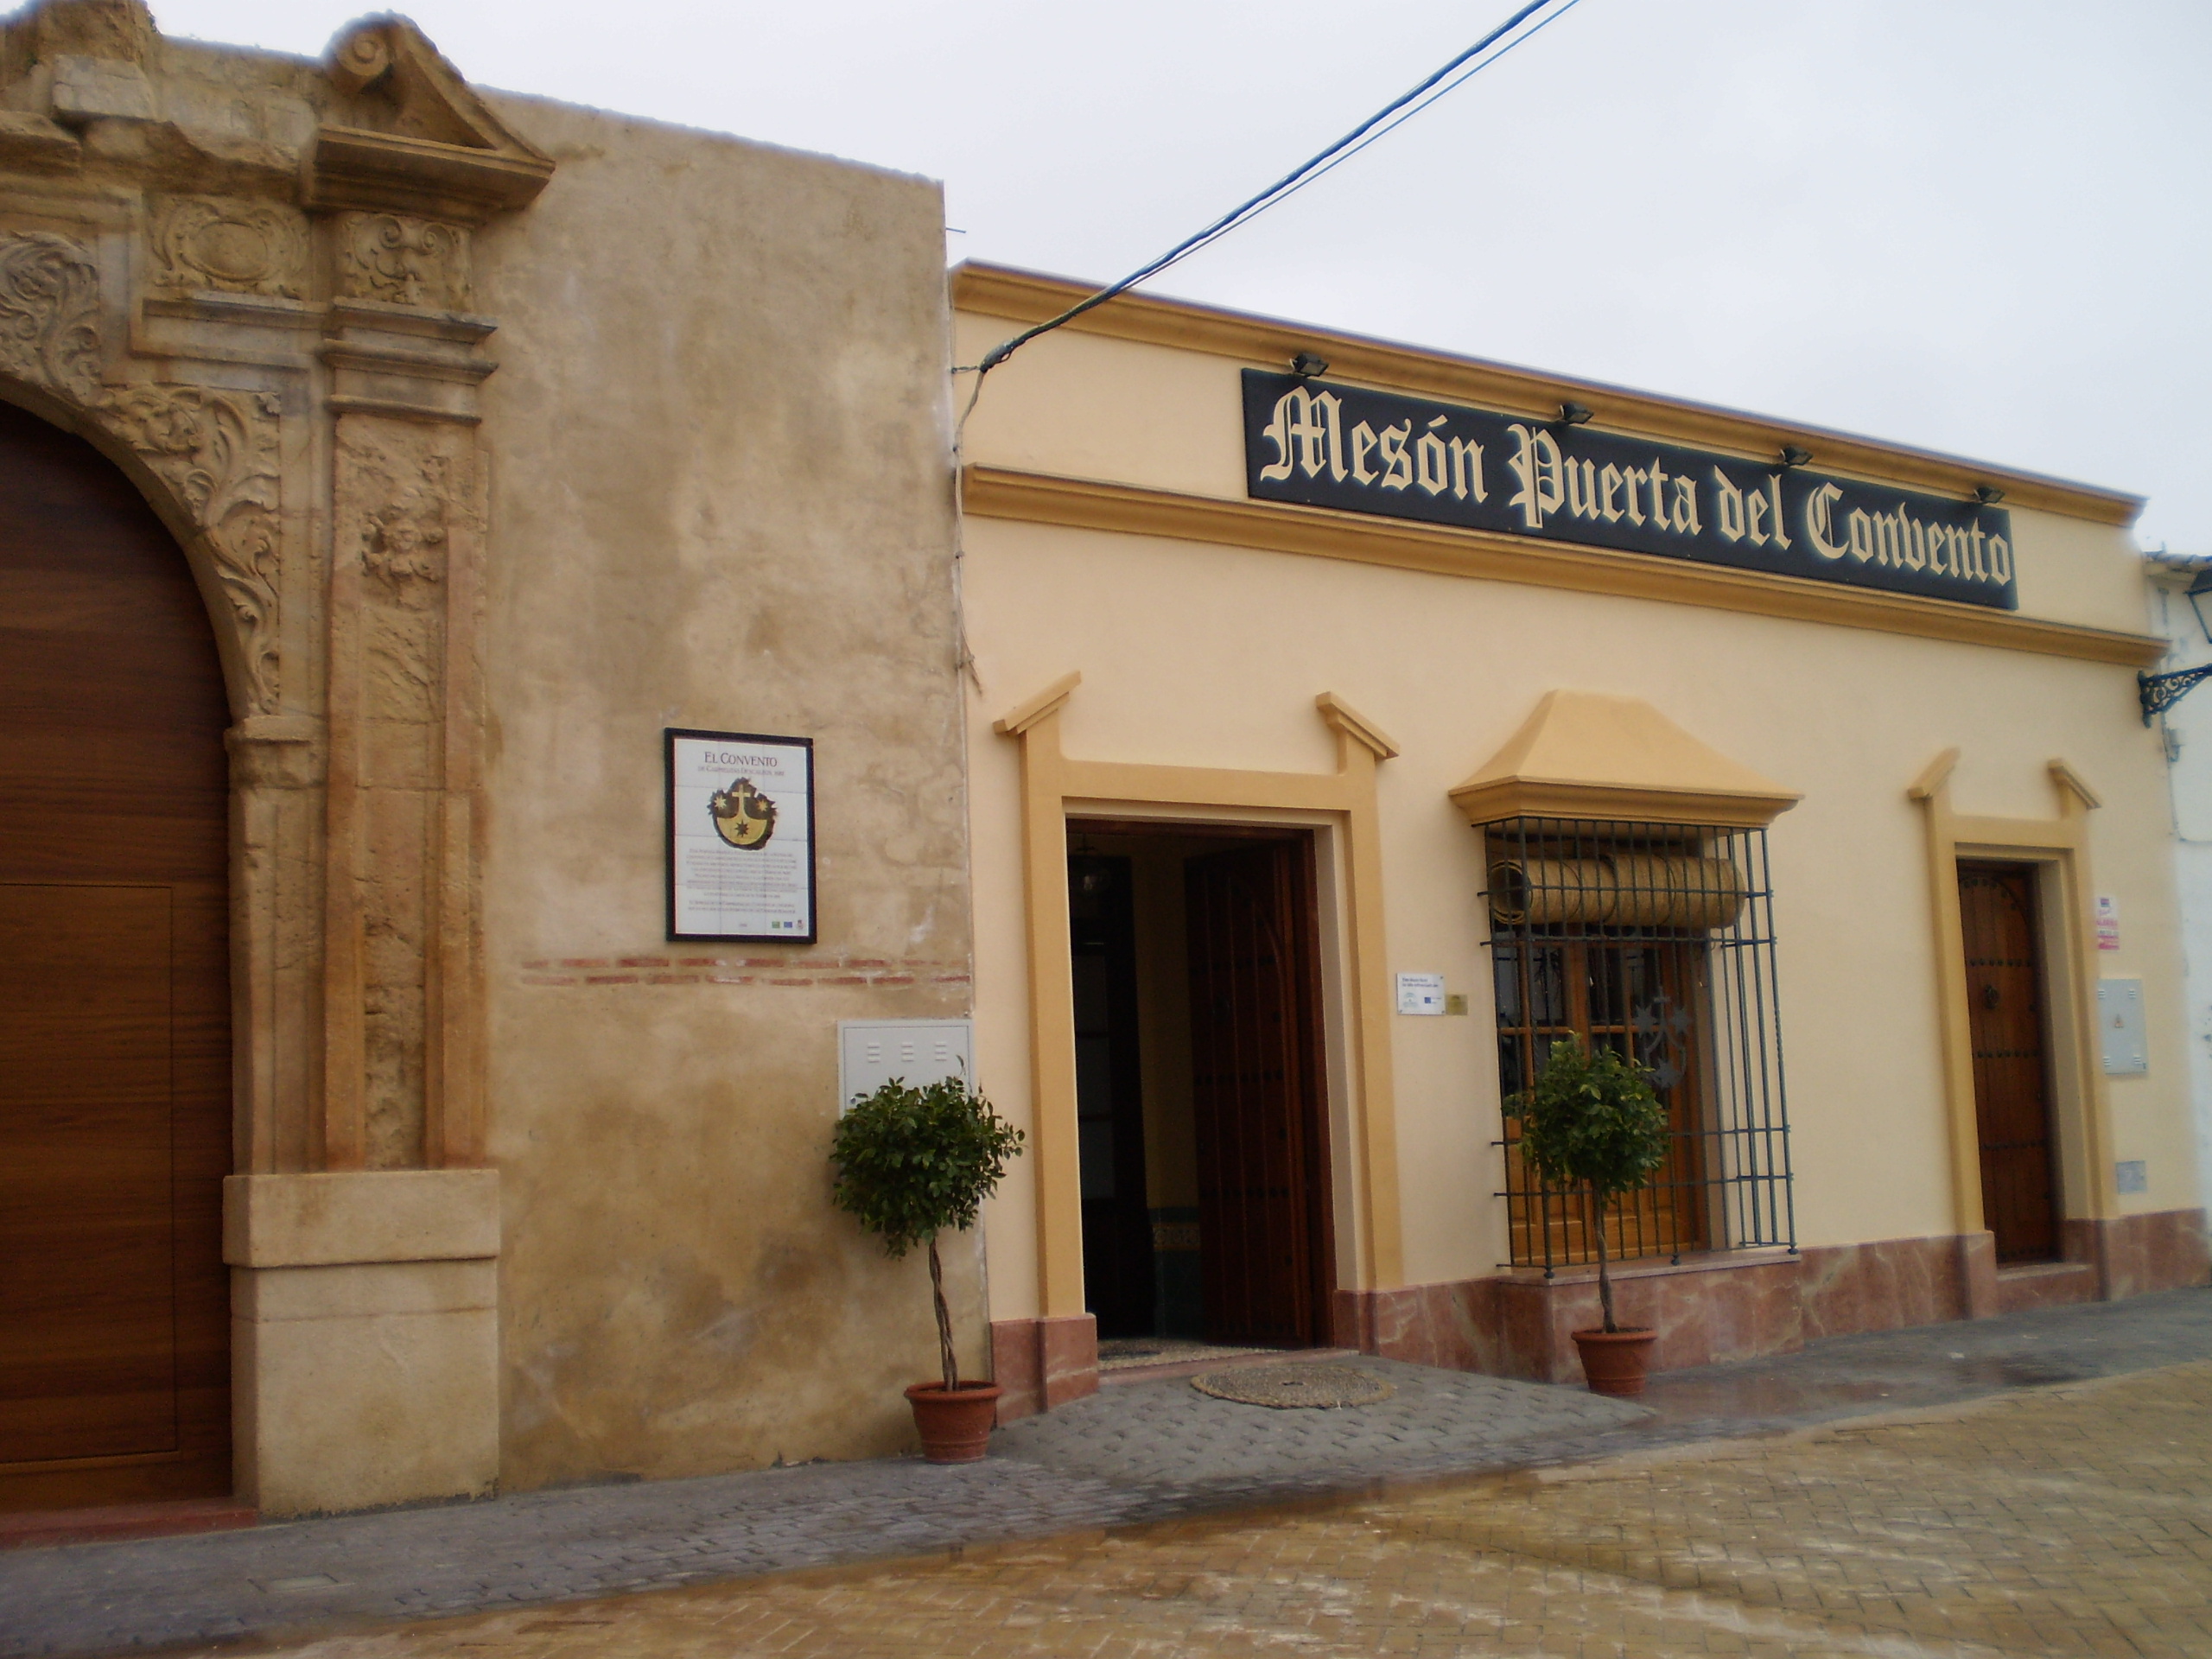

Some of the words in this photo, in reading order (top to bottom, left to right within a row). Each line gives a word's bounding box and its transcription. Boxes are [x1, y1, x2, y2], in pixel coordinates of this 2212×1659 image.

[1260, 385, 1488, 504] Mesón
[1507, 423, 1702, 537] Puerta
[1714, 464, 1792, 550] del
[1807, 482, 2012, 587] Convento
